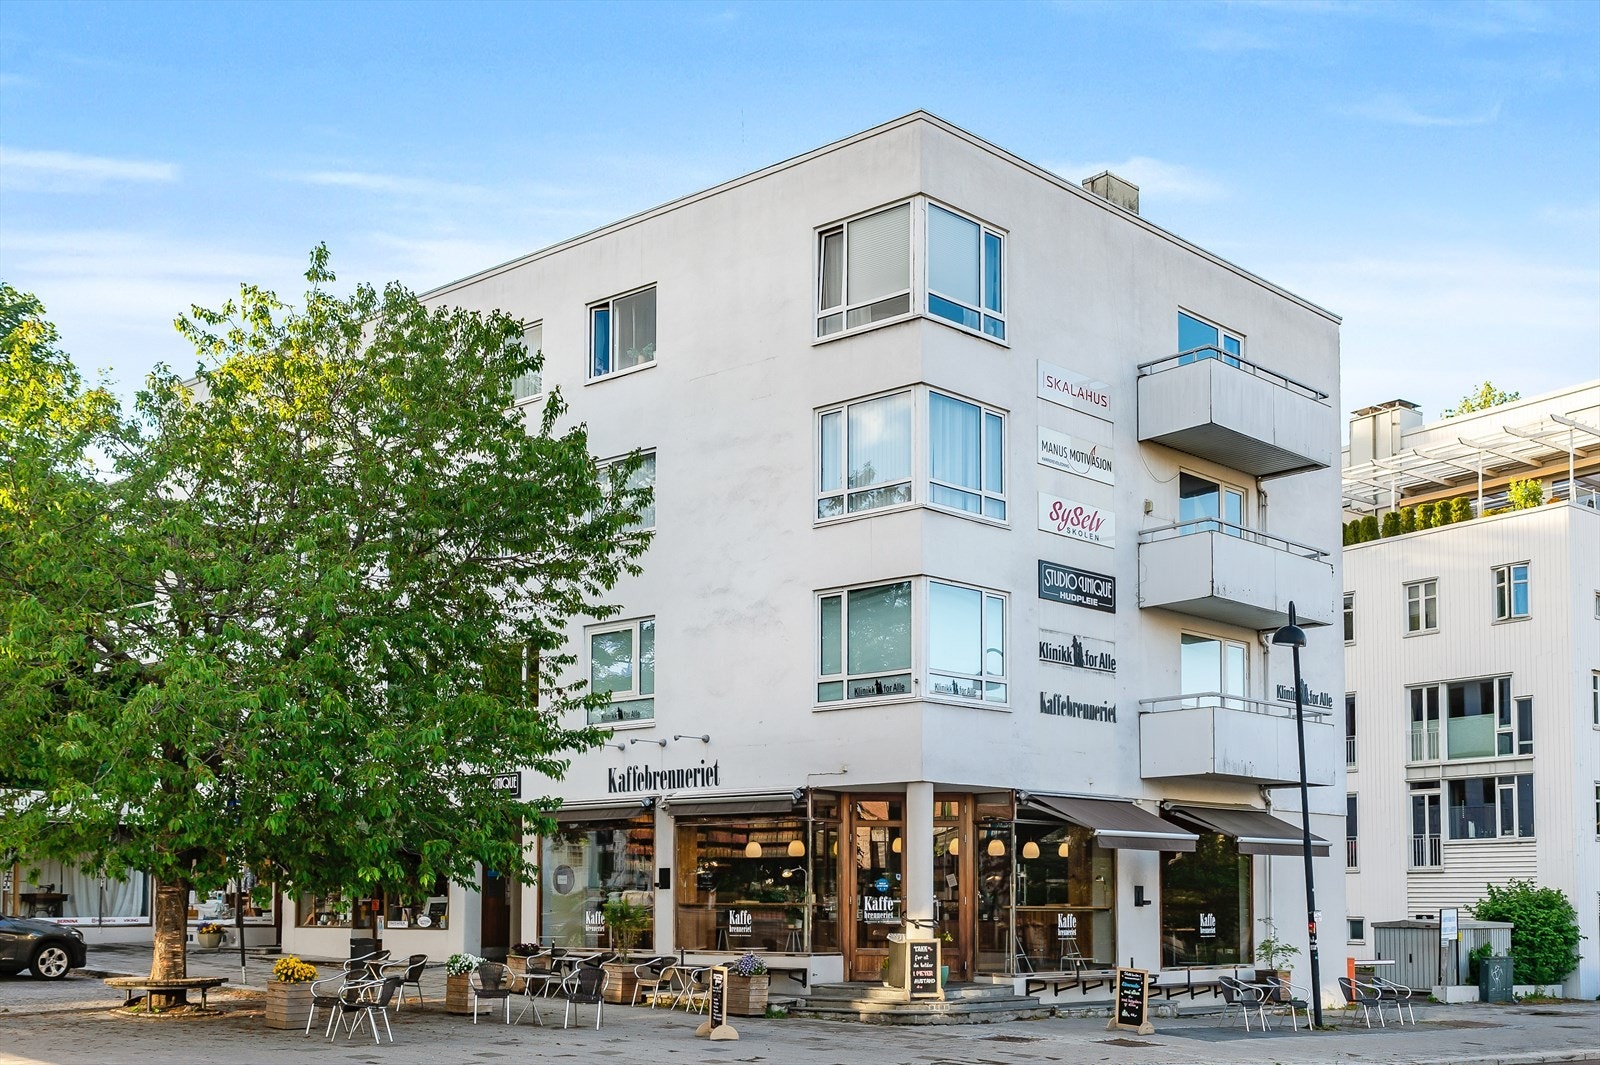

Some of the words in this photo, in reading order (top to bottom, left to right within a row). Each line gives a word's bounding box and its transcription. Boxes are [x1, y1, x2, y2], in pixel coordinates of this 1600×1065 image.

[1046, 375, 1108, 408] SKALAHUS
[1041, 439, 1068, 460] MANUS
[1069, 448, 1112, 472] MOTIVASJON
[1049, 500, 1106, 534] SySelv
[1066, 526, 1100, 541] SKOLEN
[1044, 568, 1077, 590] STUDIO
[1078, 576, 1112, 598] UNIQUE
[1059, 591, 1099, 607] HUDPLEIE
[1039, 641, 1073, 664] Klinikk
[1084, 649, 1098, 667] for
[1099, 652, 1116, 671] Alle
[854, 684, 876, 696] Klinikk
[883, 683, 893, 694] for
[893, 682, 905, 693] Alle
[1309, 690, 1319, 705] for
[1319, 692, 1333, 708] Alle
[1039, 691, 1117, 724] Kaffebrenneriet
[607, 759, 721, 793] Kaffebrenneriet
[864, 895, 894, 911] Kaffe
[585, 910, 605, 925] Kaffe
[728, 909, 752, 926] Kaffe
[864, 910, 894, 920] brenneriet
[1057, 913, 1077, 928] Kaffe
[1199, 913, 1216, 927] Kaffe
[728, 923, 752, 933] brenneriet
